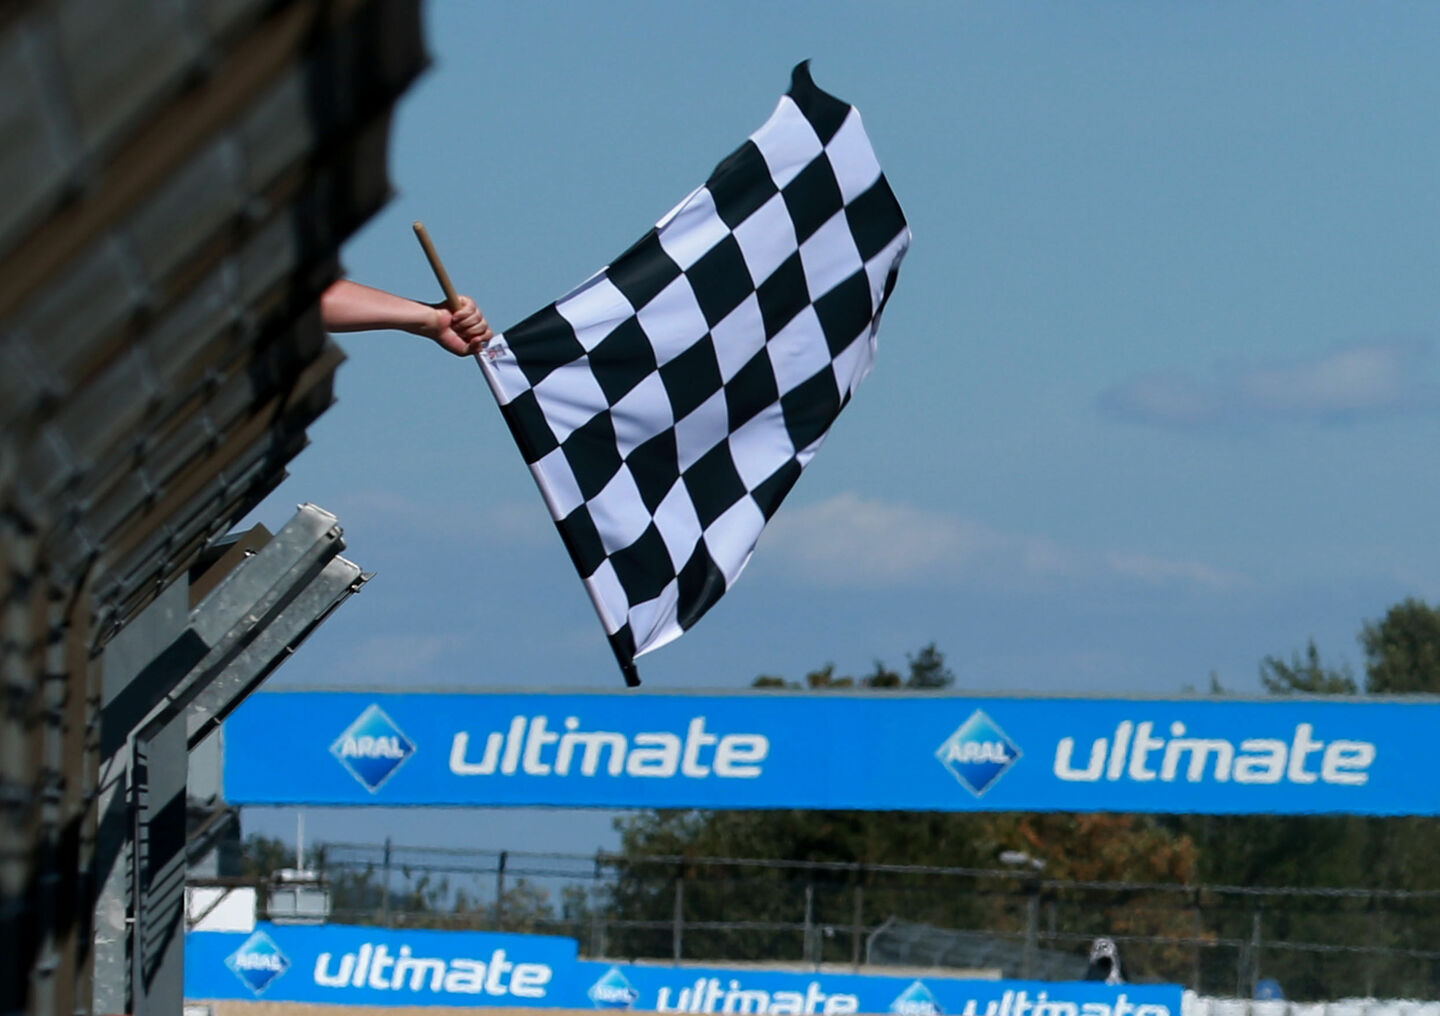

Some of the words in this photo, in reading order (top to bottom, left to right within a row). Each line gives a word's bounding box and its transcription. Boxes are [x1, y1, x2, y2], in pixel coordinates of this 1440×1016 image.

[339, 736, 405, 760] ARAL
[448, 715, 769, 778] ultimate
[947, 742, 1009, 765] ARAL
[1054, 720, 1376, 785] ultimate
[236, 953, 281, 971] ARAL
[314, 942, 552, 998] ultimate
[656, 977, 859, 1016] ultimate
